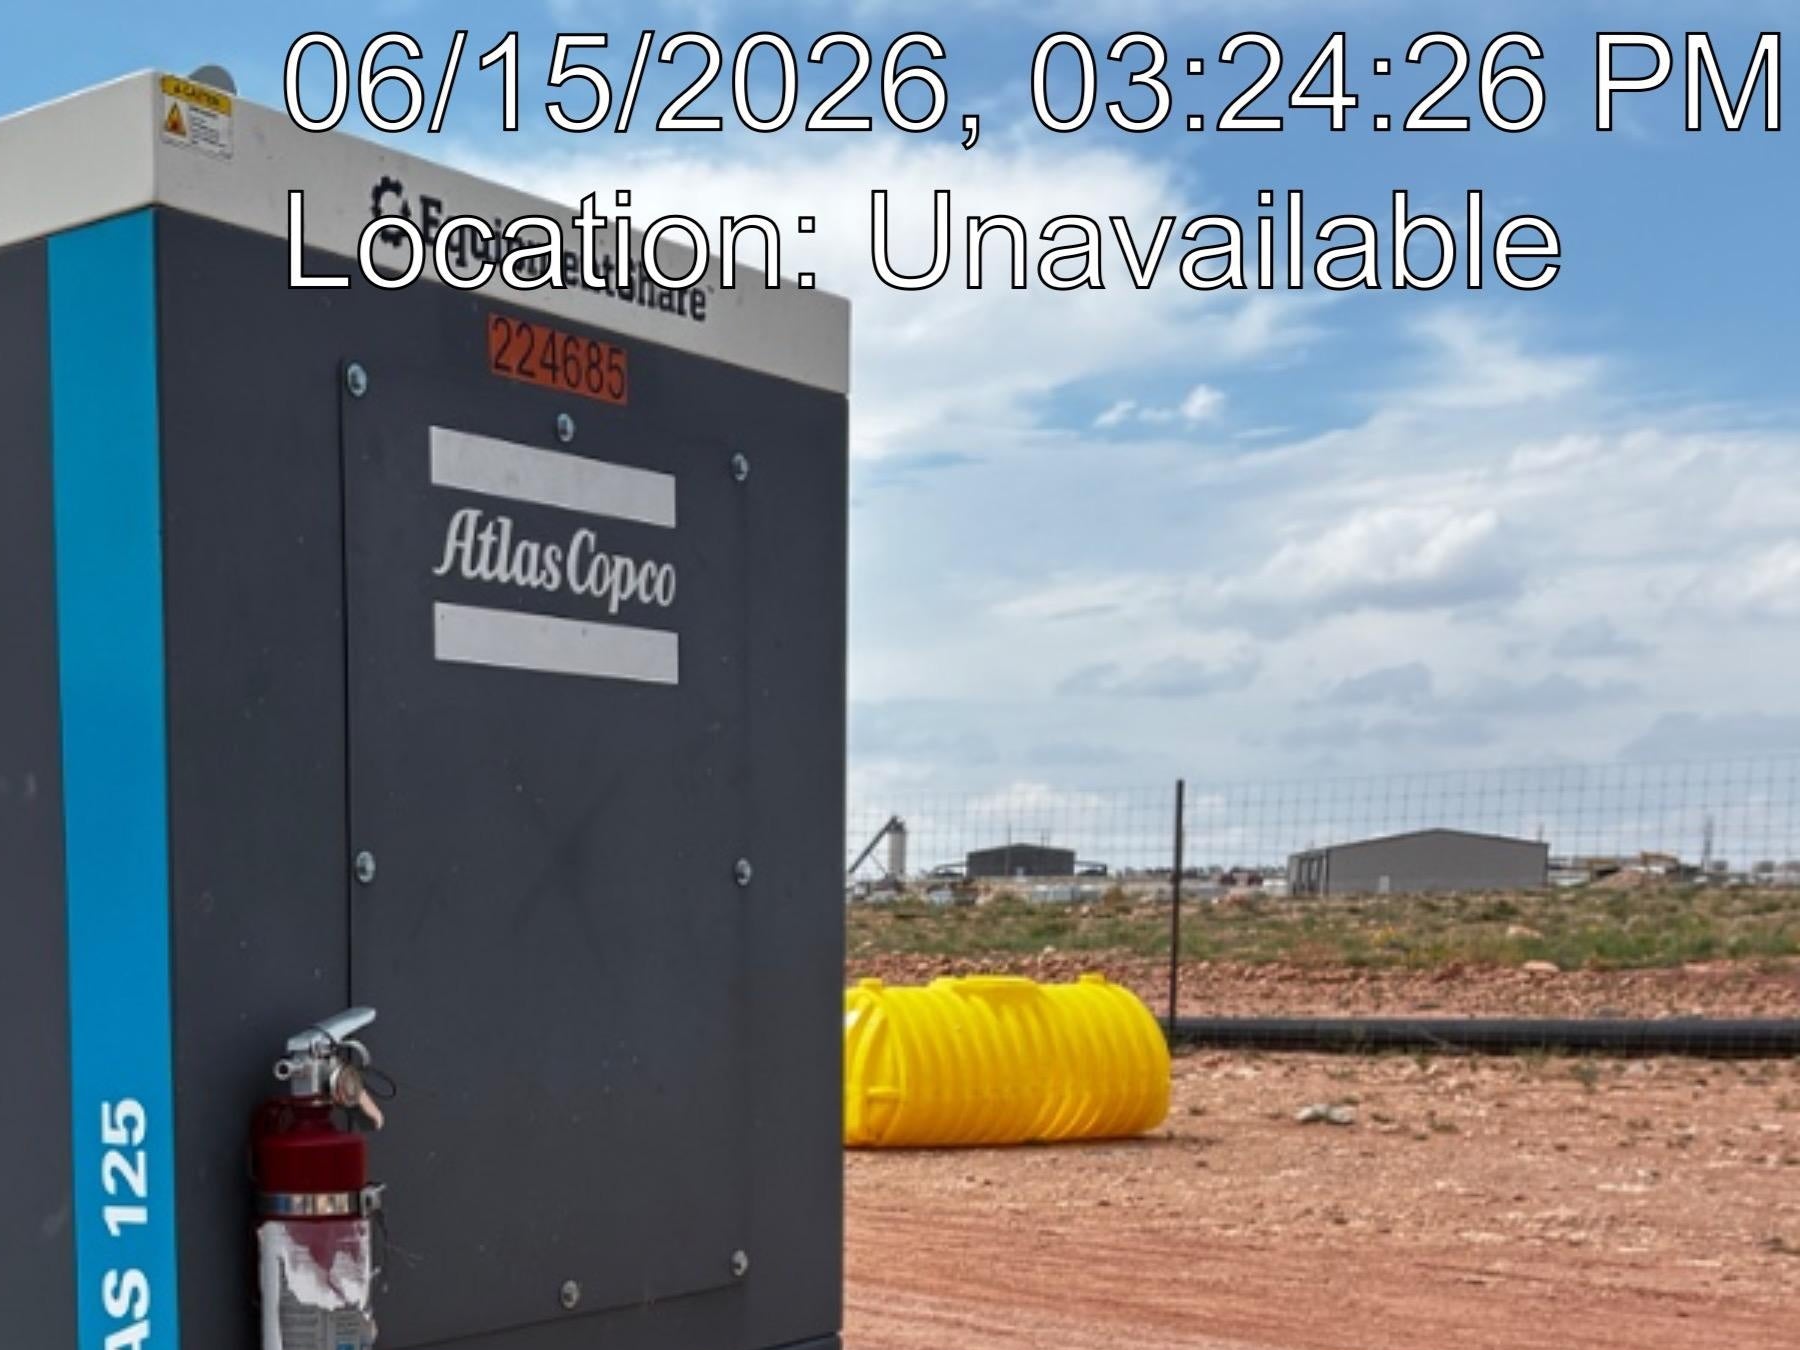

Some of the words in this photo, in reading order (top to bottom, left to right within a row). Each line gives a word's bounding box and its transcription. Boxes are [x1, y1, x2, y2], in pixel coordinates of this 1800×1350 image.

[491, 317, 625, 400] 224685
[432, 508, 562, 593] Atlas
[566, 527, 676, 614] Copco
[100, 1097, 149, 1237] 125
